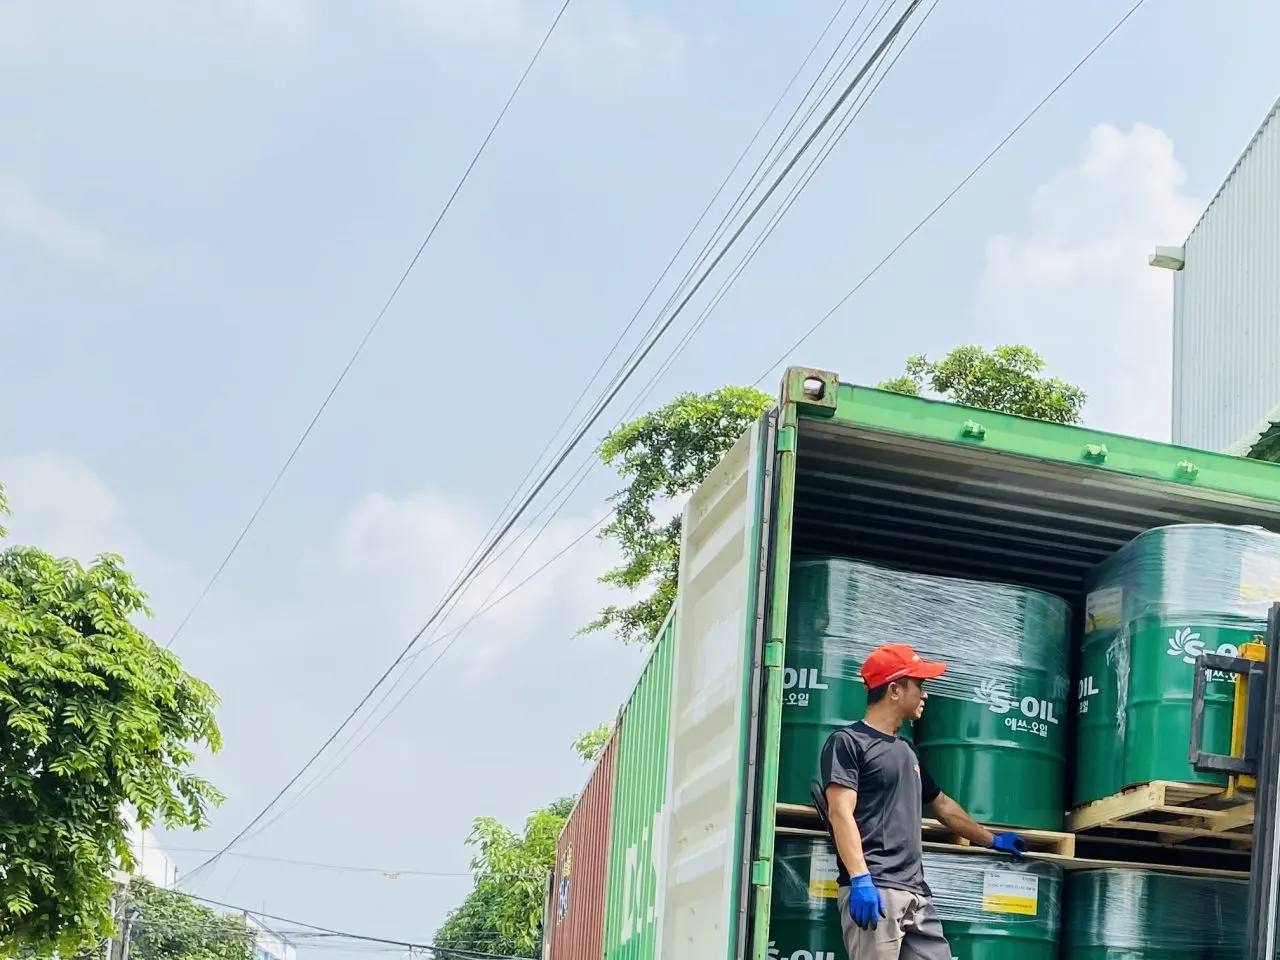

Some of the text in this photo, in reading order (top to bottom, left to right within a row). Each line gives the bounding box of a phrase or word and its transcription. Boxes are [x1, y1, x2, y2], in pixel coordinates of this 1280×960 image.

[782, 693, 809, 707] -오일
[988, 690, 1059, 724] S-OIL
[1004, 717, 1048, 738] 에쓰-오일
